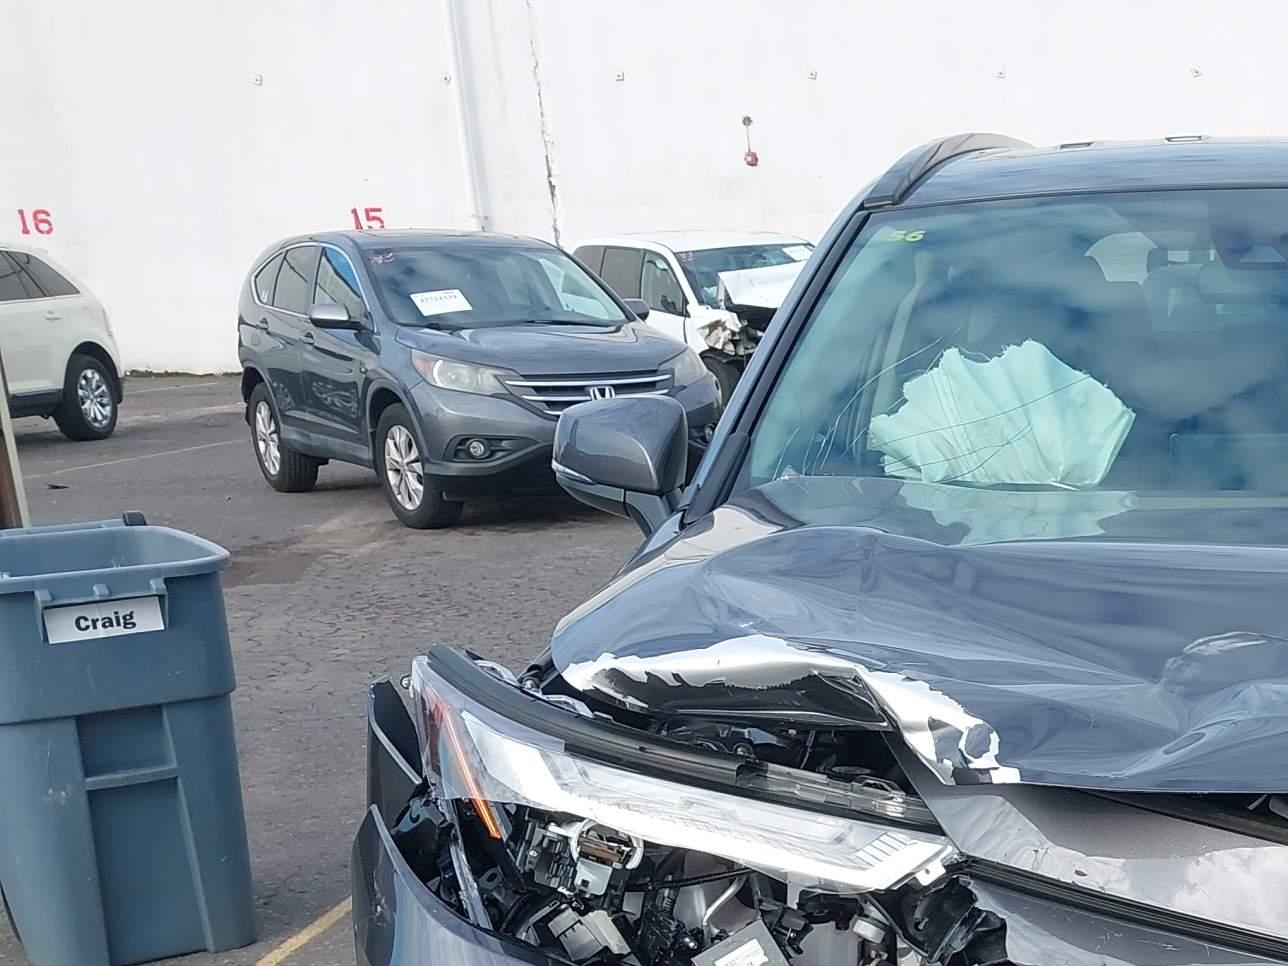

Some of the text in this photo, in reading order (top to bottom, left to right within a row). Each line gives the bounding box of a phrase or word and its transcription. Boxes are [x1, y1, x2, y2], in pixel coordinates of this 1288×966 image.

[17, 208, 53, 235] 16
[351, 207, 385, 231] 15
[75, 610, 137, 631] Craig
